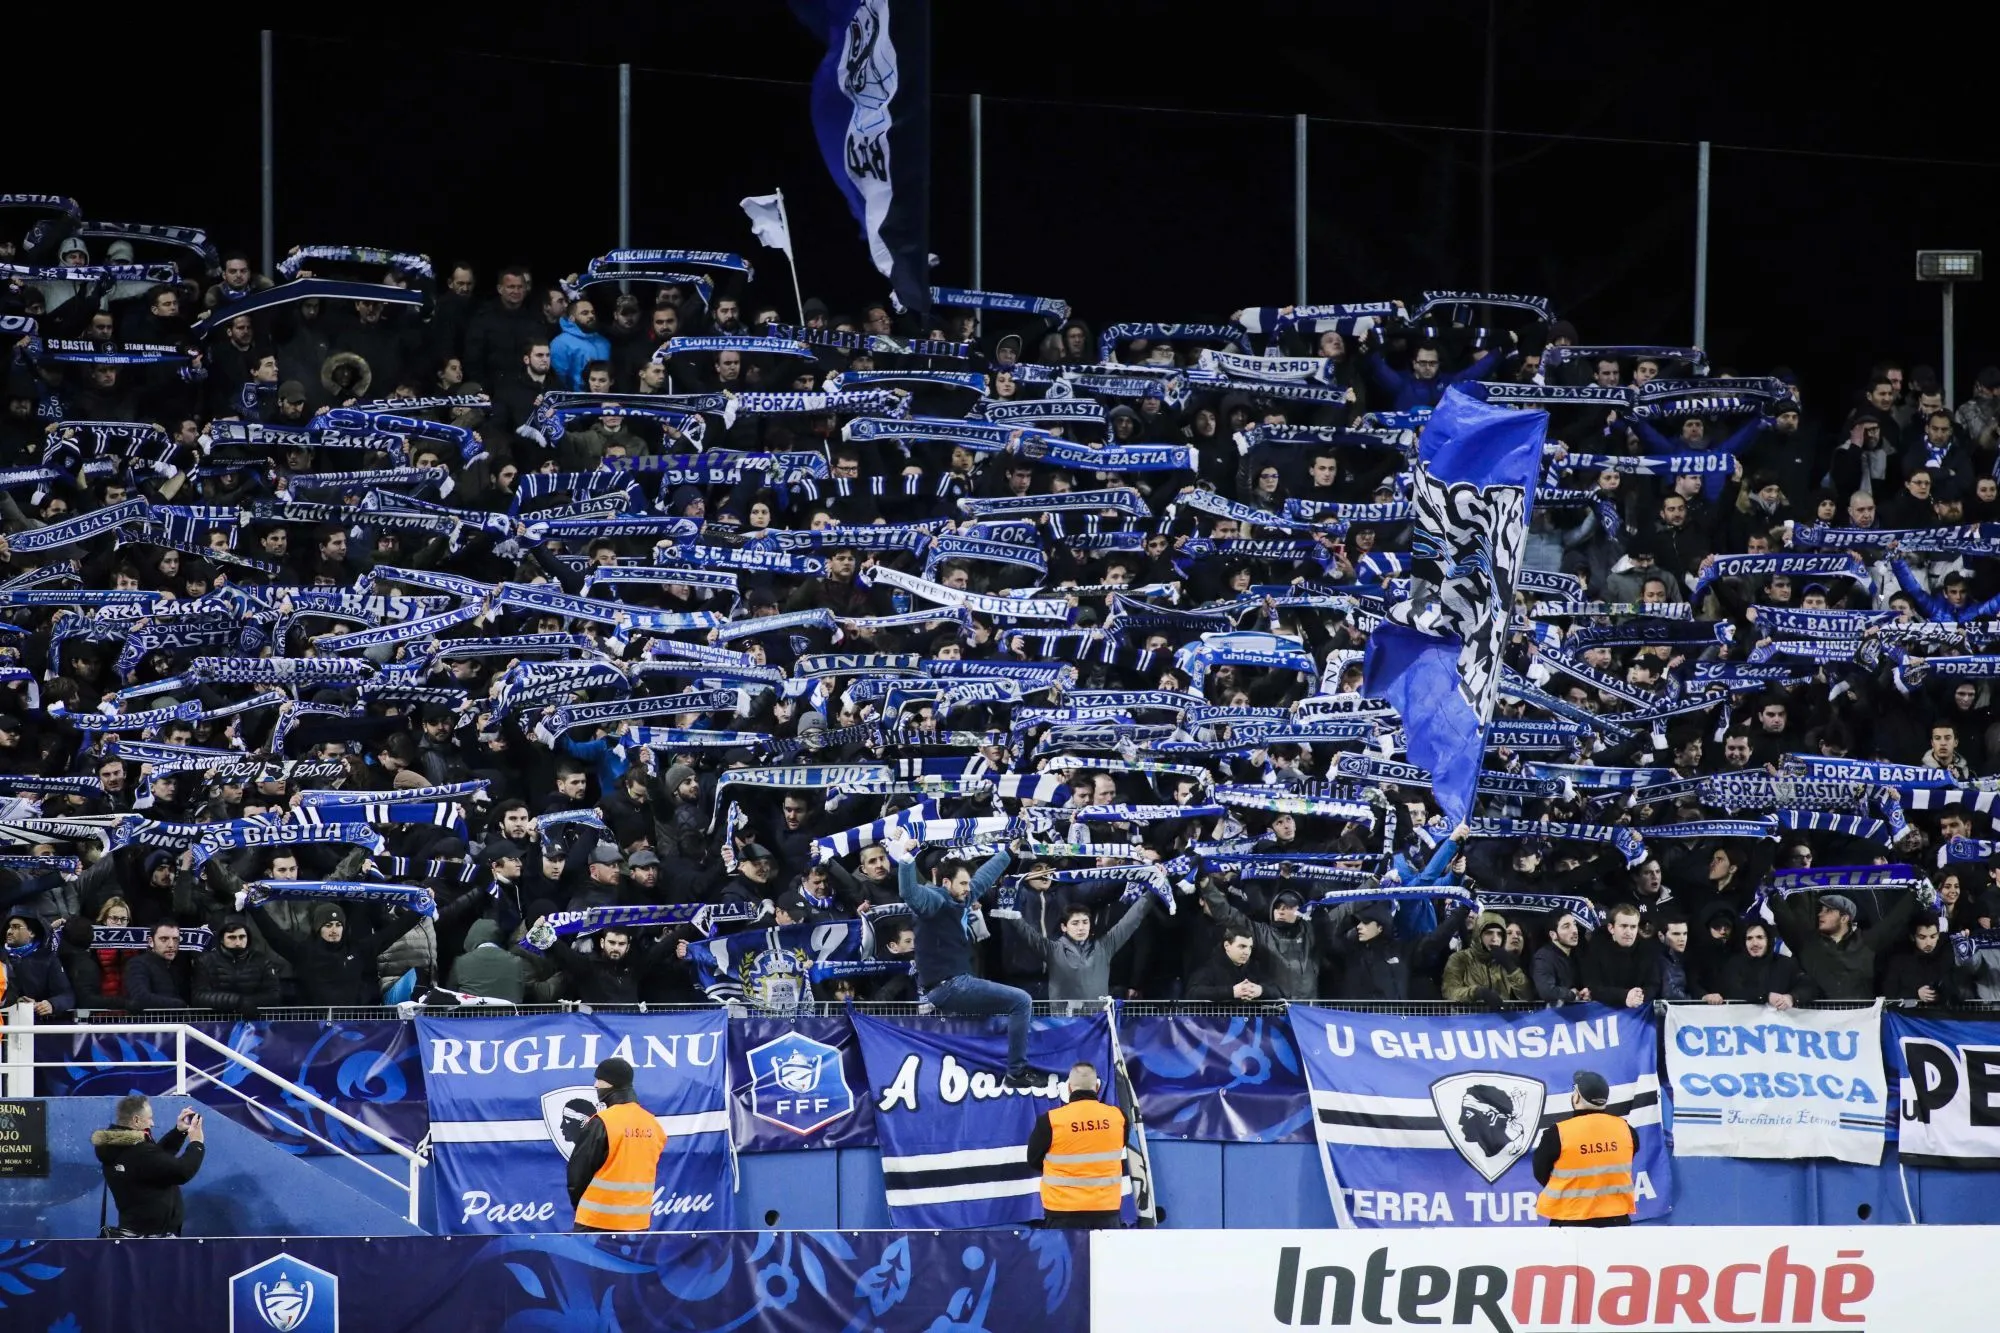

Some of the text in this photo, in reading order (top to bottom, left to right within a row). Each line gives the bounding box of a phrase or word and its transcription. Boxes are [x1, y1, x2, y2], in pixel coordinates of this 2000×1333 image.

[62, 340, 94, 352] BASTIA
[1488, 385, 1626, 399] ORZA BASTIA
[752, 398, 805, 411] FORZA
[986, 402, 1104, 420] FORZA BASTI
[940, 426, 1000, 440] BASTIA
[1051, 447, 1167, 465] FORZA BASTIA
[581, 497, 629, 513] BASTI
[1048, 492, 1130, 505] BASTIA
[29, 504, 142, 548] FORZA BASTIA
[733, 547, 791, 564] BASTIA
[984, 544, 1041, 564] BASTIA
[1719, 557, 1848, 576] FORZA BASTIA
[1522, 573, 1583, 599] BASTIA
[965, 595, 1067, 618] FURIANI
[398, 614, 461, 637] BASTIA
[1807, 617, 1866, 631] BASTIA
[219, 659, 360, 672] FORZA BASTIA
[1223, 653, 1288, 665] uhlsport
[1936, 663, 1990, 674] FORZA
[572, 693, 706, 721] FORZA BASTIA
[1234, 723, 1365, 739] FORZA BASTIA
[1493, 732, 1561, 744] BASTIA
[217, 761, 343, 778] FORZA BASTIA
[1379, 763, 1431, 781] FORZ
[1813, 763, 1945, 782] FORZA BASTIA
[1719, 781, 1852, 798] FORZA BASTIA
[200, 823, 341, 854] SC BASTIA
[1522, 896, 1590, 919] BASTIA
[1326, 1014, 1620, 1061] U GHJUNSANI
[1675, 1024, 1860, 1062] CENTRU
[428, 1030, 724, 1075] RUGLIANU
[878, 1054, 922, 1112] A
[1678, 1071, 1878, 1104] CORSICA
[461, 1190, 555, 1225] Paese
